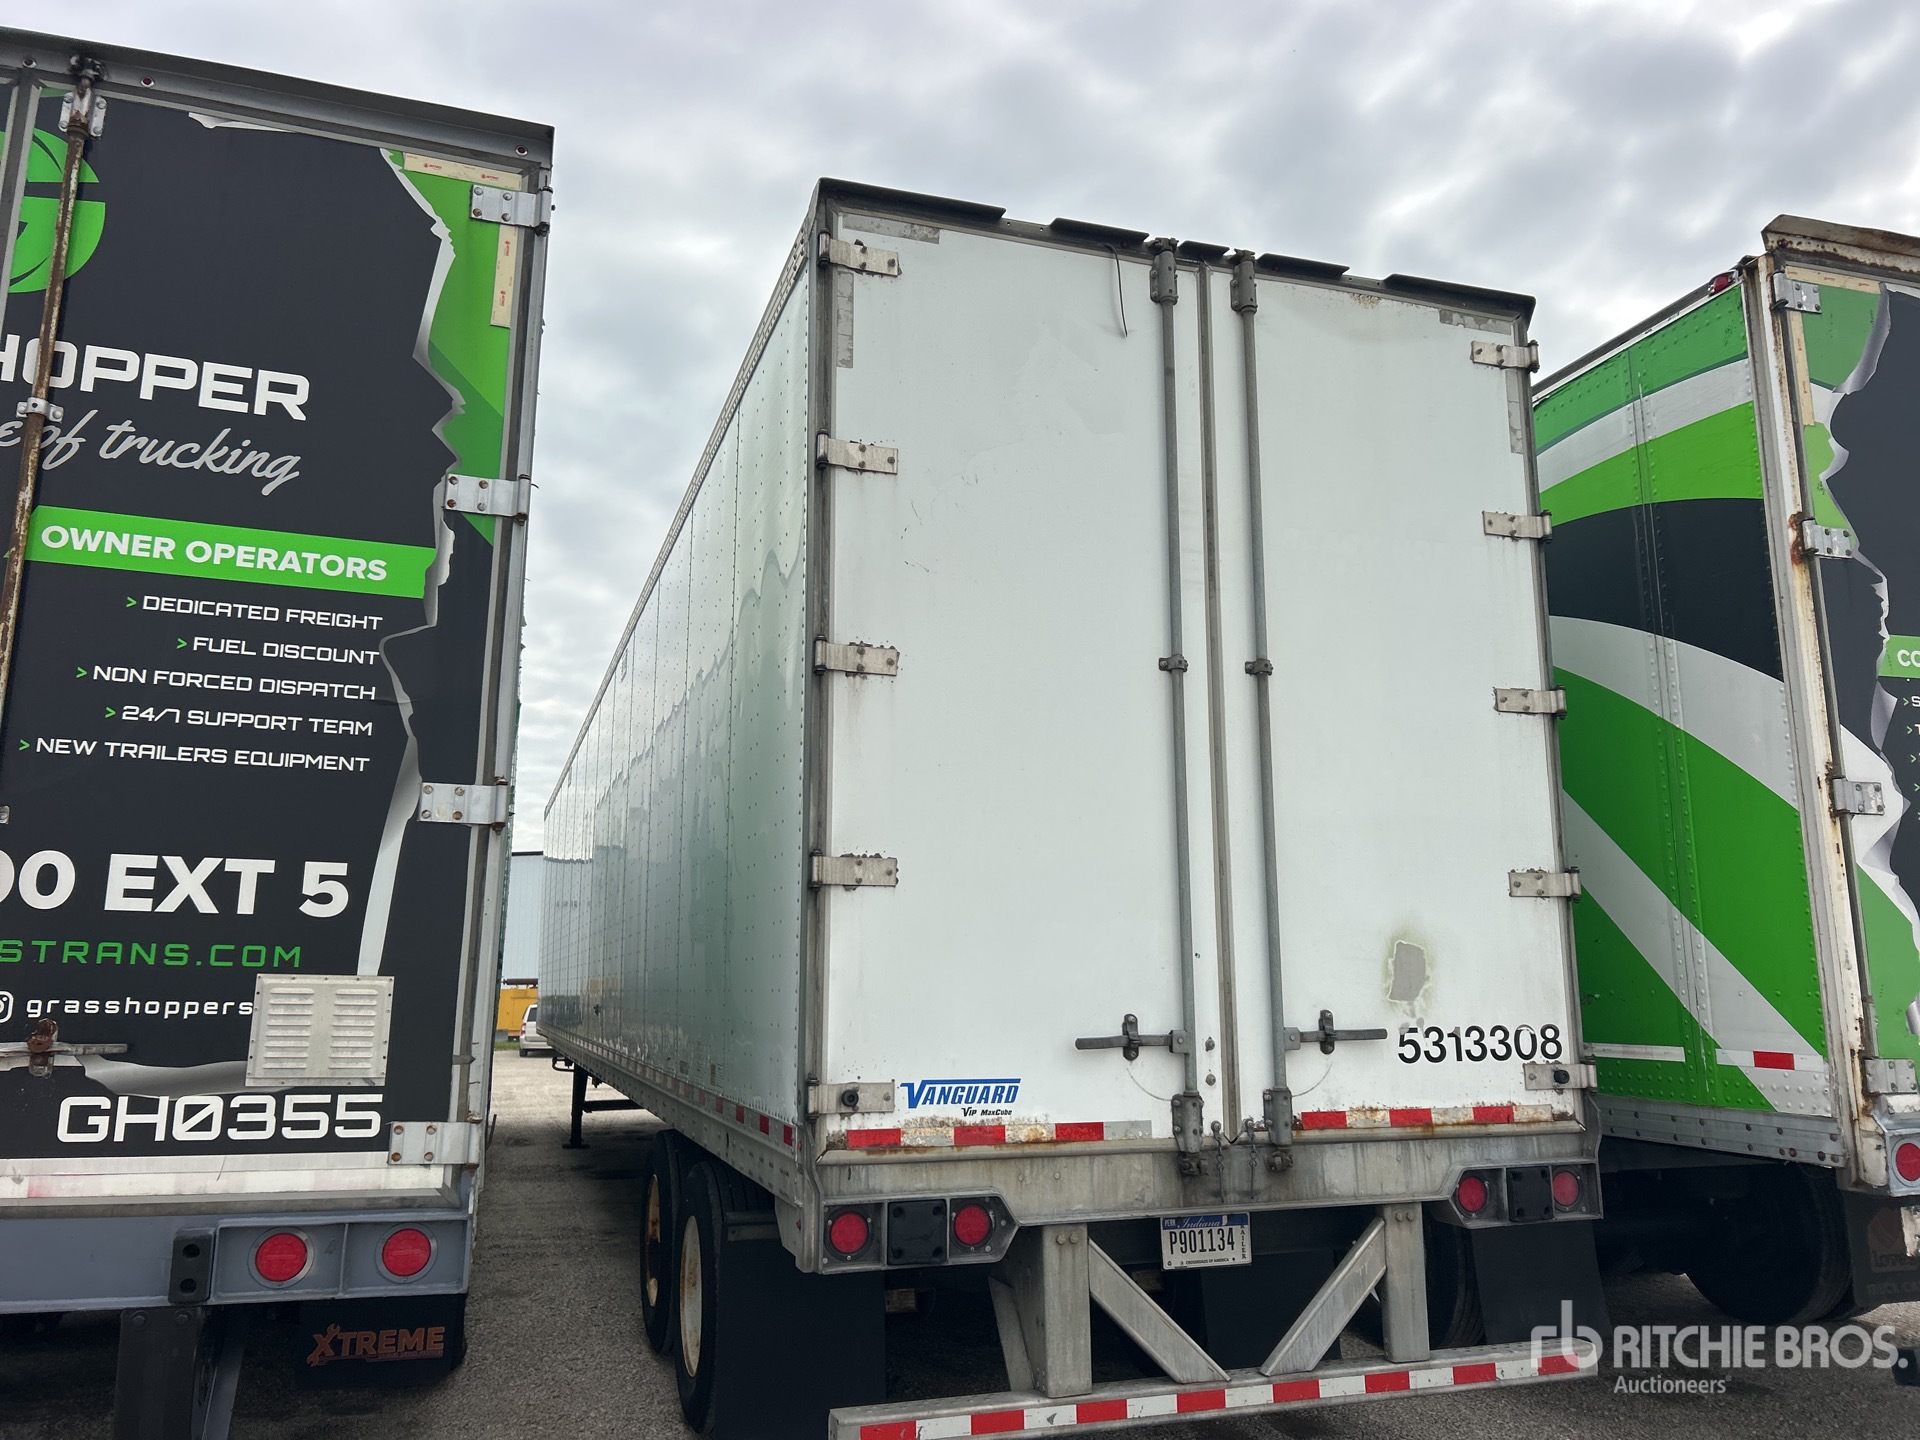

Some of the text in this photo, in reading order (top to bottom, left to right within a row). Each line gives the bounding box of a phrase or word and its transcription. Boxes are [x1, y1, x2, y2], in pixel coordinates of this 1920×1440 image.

[99, 420, 301, 496] trucking
[41, 525, 388, 581] OWNER OPERATORS
[142, 595, 384, 630] DEDICATED FREIGHT
[192, 636, 380, 665] FUEL DISCOUNT
[93, 665, 376, 701] NON FORCED DISPATCH
[121, 705, 373, 736] 24/7 SUPPORT TEAM
[36, 738, 371, 772] NEW TRAILERS EQUIPMENT
[0, 849, 349, 918] 0 EXT 5
[26, 996, 253, 1019] grasshoppers
[1397, 1023, 1563, 1065] 5313308
[900, 1078, 1022, 1109] VANGUARD
[57, 1093, 383, 1143] GH0355
[1180, 1216, 1220, 1228] Indiana
[1169, 1227, 1235, 1254] P901134
[306, 1323, 446, 1367] XTREME
